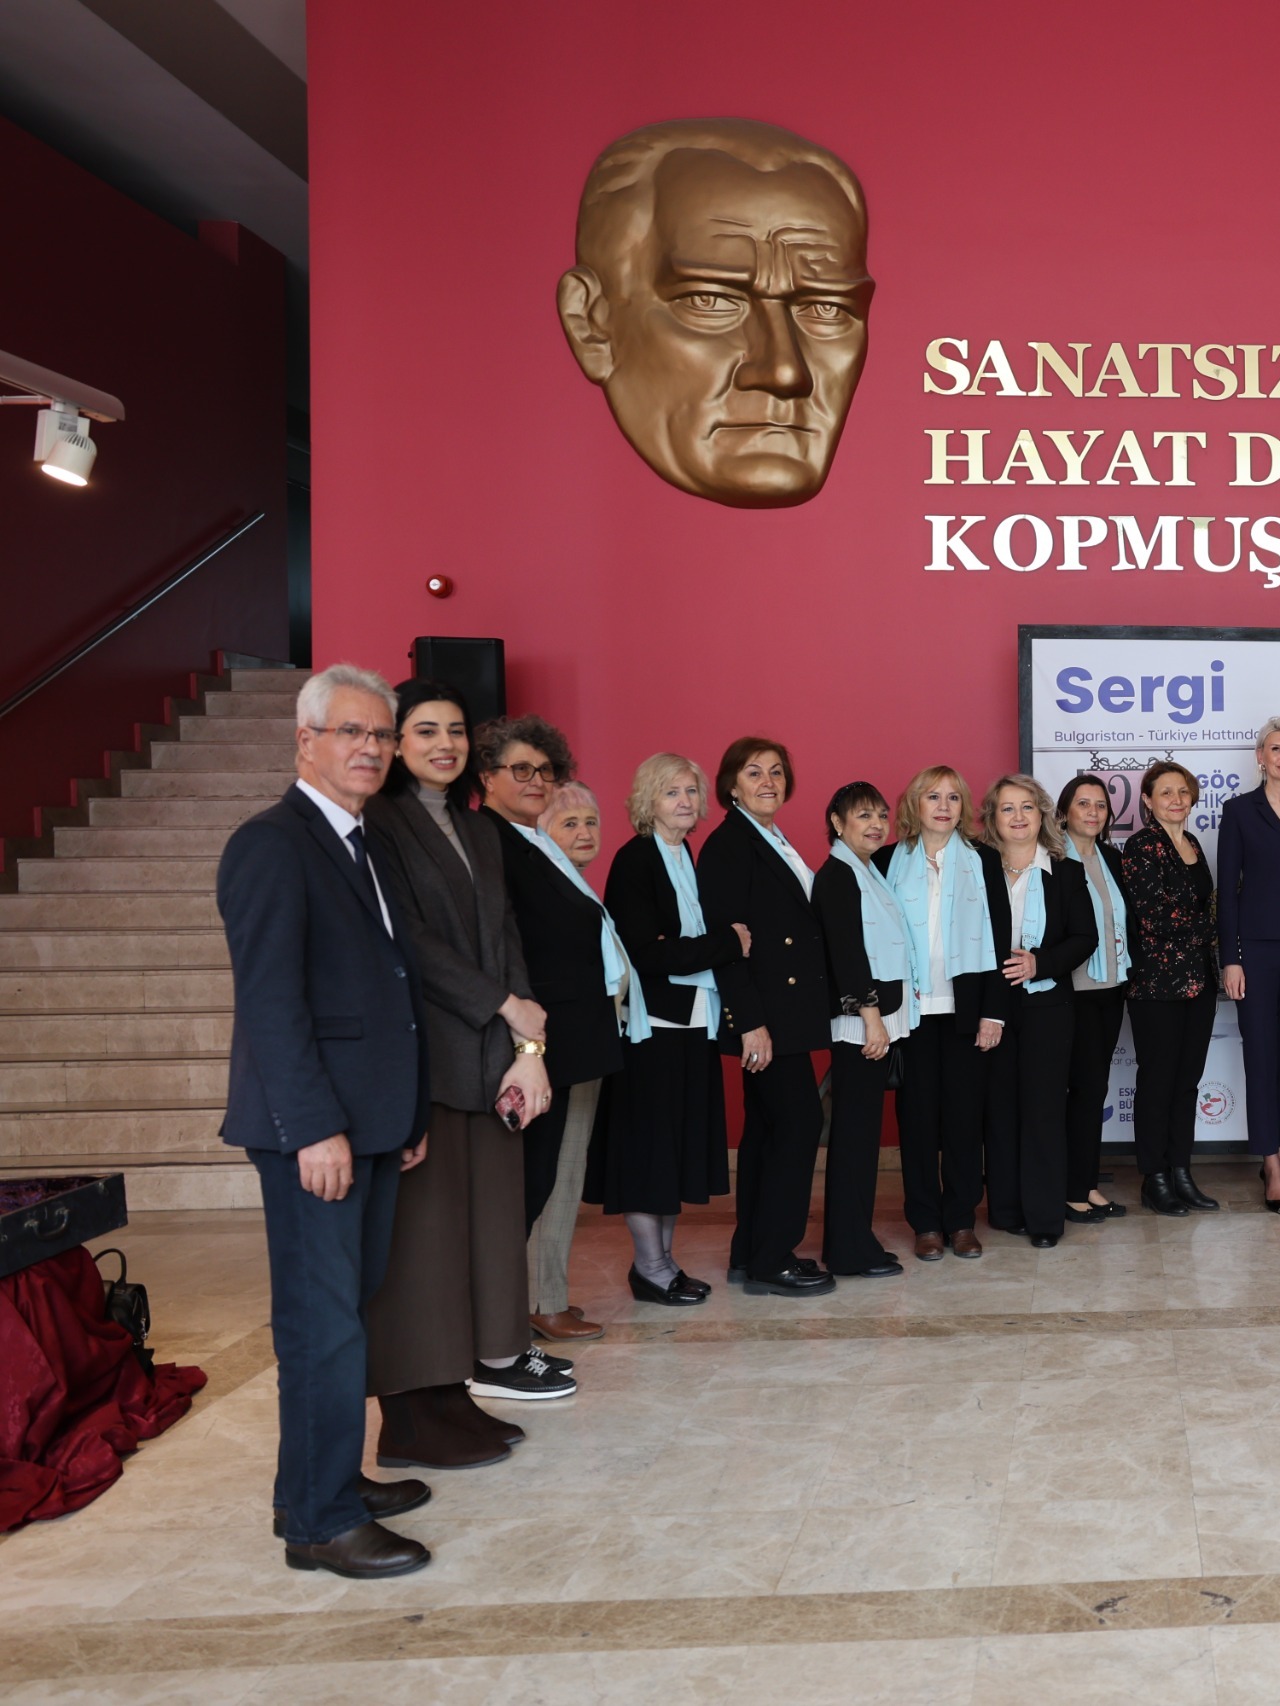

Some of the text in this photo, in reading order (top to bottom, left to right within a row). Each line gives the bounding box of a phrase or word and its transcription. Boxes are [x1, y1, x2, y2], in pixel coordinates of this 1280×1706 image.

[923, 429, 1208, 487] HAYAT
[1056, 660, 1225, 724] Sergi
[1054, 731, 1135, 744] Bulgaristan
[1148, 729, 1198, 742] Türkiye
[1196, 769, 1240, 791] GÖÇ
